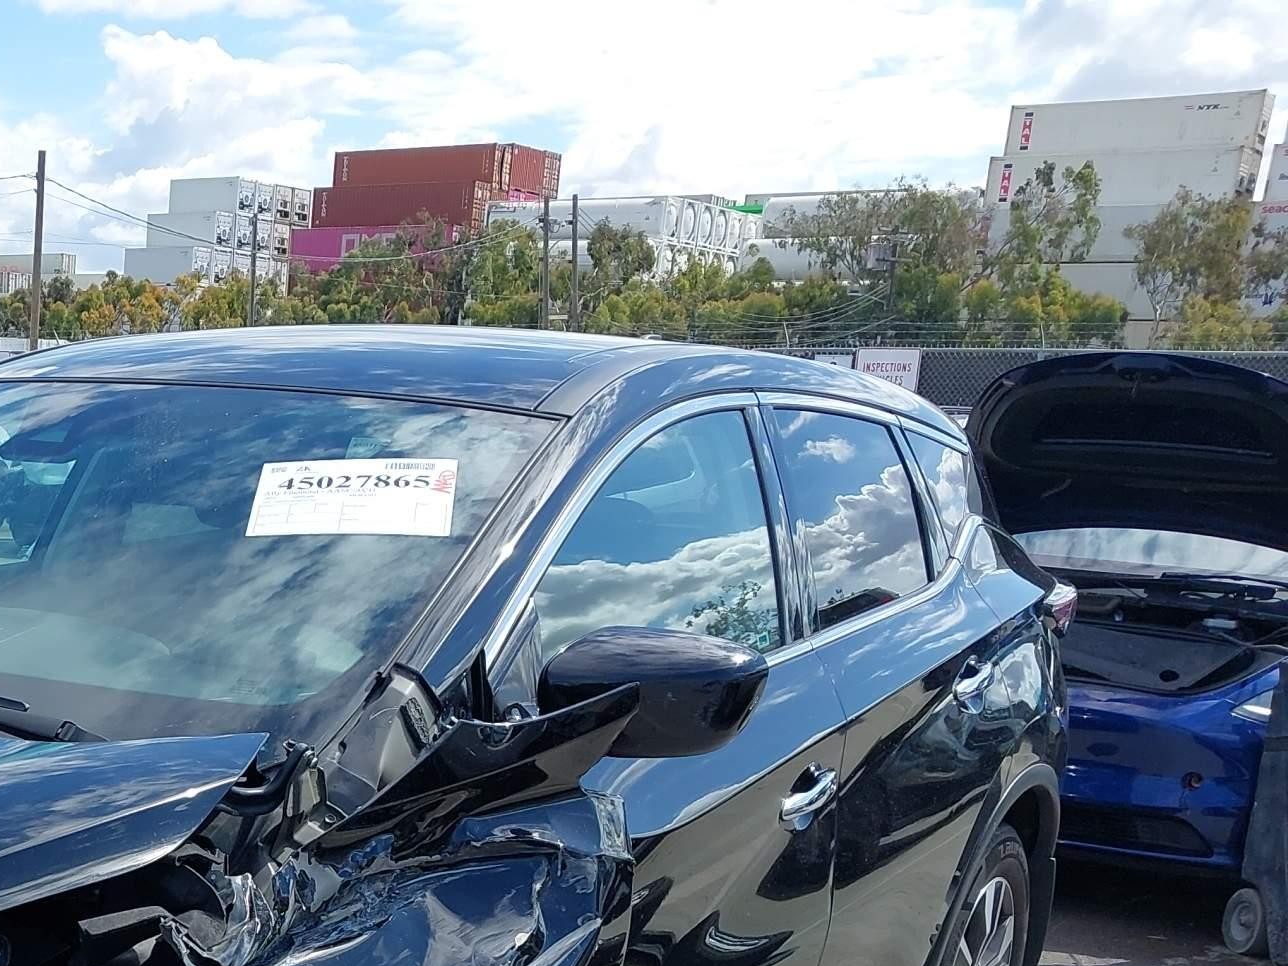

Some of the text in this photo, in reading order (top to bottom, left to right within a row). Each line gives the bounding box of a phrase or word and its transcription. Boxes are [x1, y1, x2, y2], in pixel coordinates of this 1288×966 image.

[1021, 118, 1032, 144] TAL
[1000, 170, 1011, 196] TAL
[862, 362, 912, 373] INSPECTIONS
[278, 474, 430, 490] 45027865
